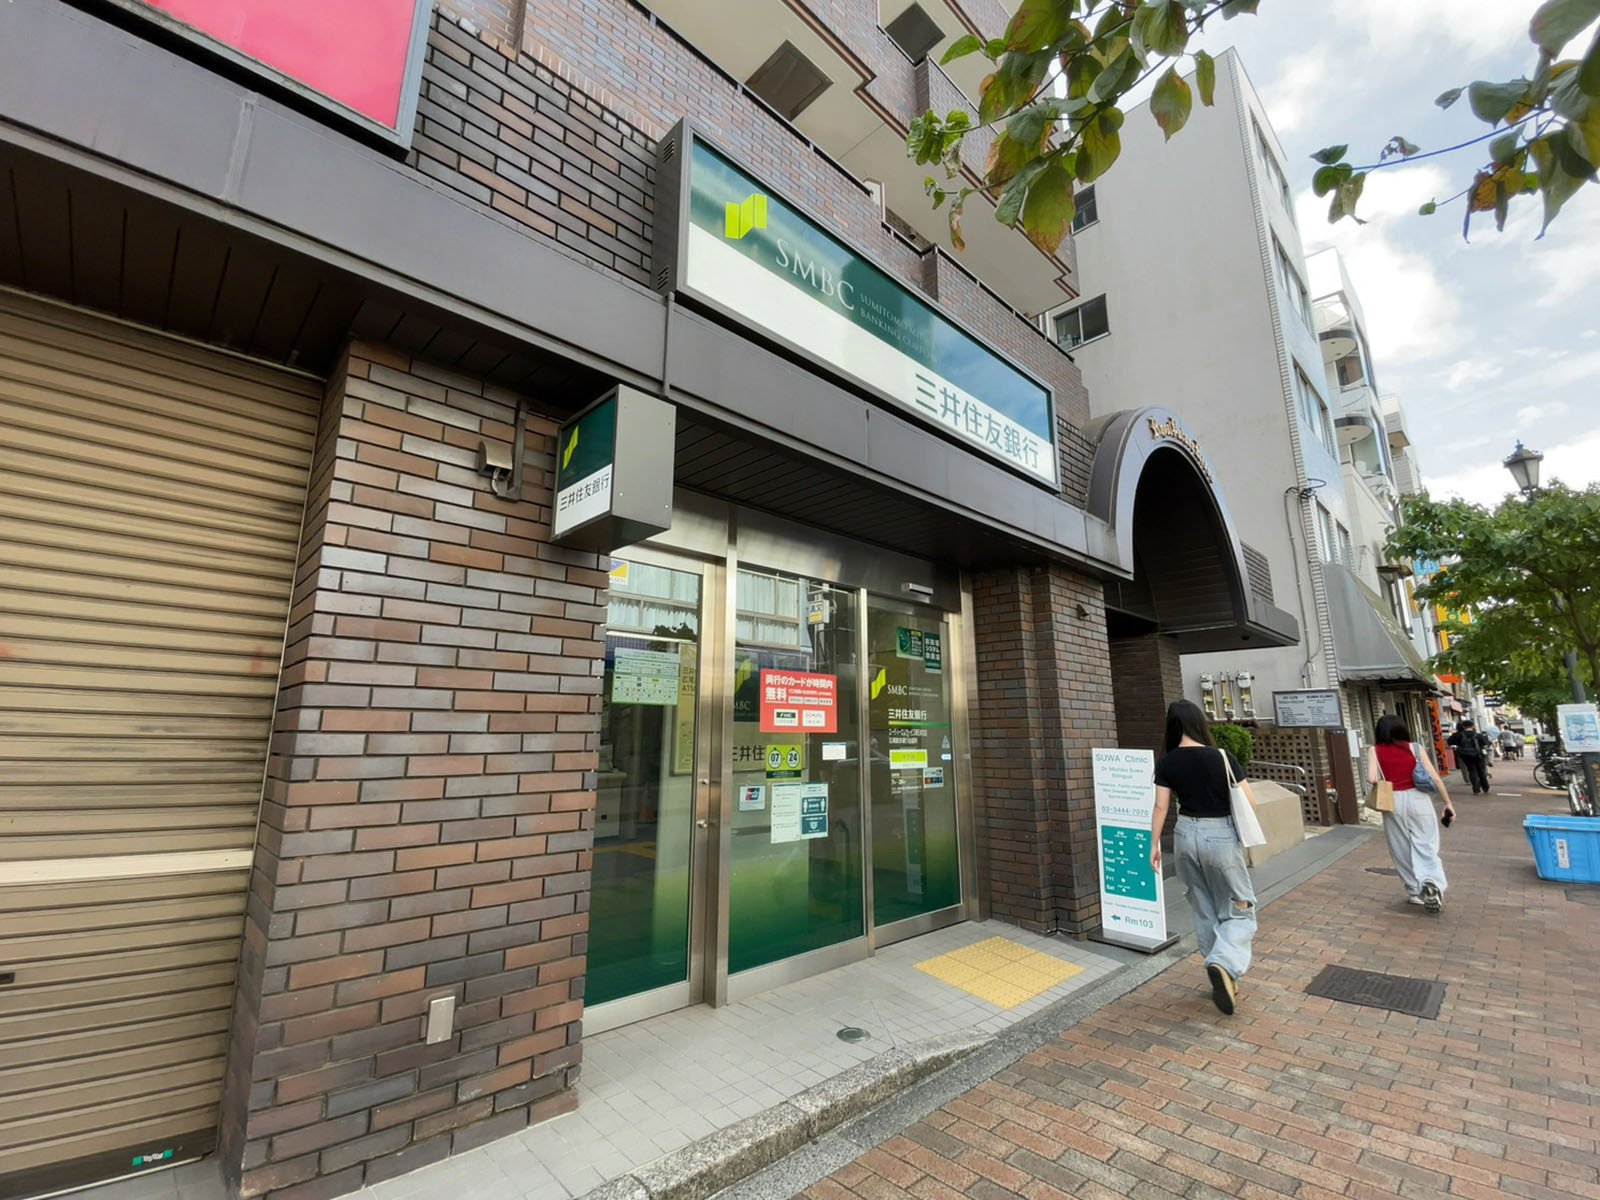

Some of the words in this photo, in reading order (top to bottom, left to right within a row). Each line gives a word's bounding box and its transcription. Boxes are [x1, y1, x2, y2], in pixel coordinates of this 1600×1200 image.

[776, 238, 855, 311] SMBC
[915, 372, 1040, 470] 三井住友銀行
[560, 472, 610, 512] 三井住友銀行
[765, 686, 787, 700] 無料
[887, 684, 908, 696] SMBC
[888, 708, 927, 720] 三井住友銀行
[770, 753, 780, 762] 07
[788, 752, 798, 762] 24
[1095, 753, 1121, 762] SUWA
[1124, 754, 1149, 764] Clinic
[1105, 874, 1115, 882] Fri
[1124, 915, 1154, 929] Rm103
